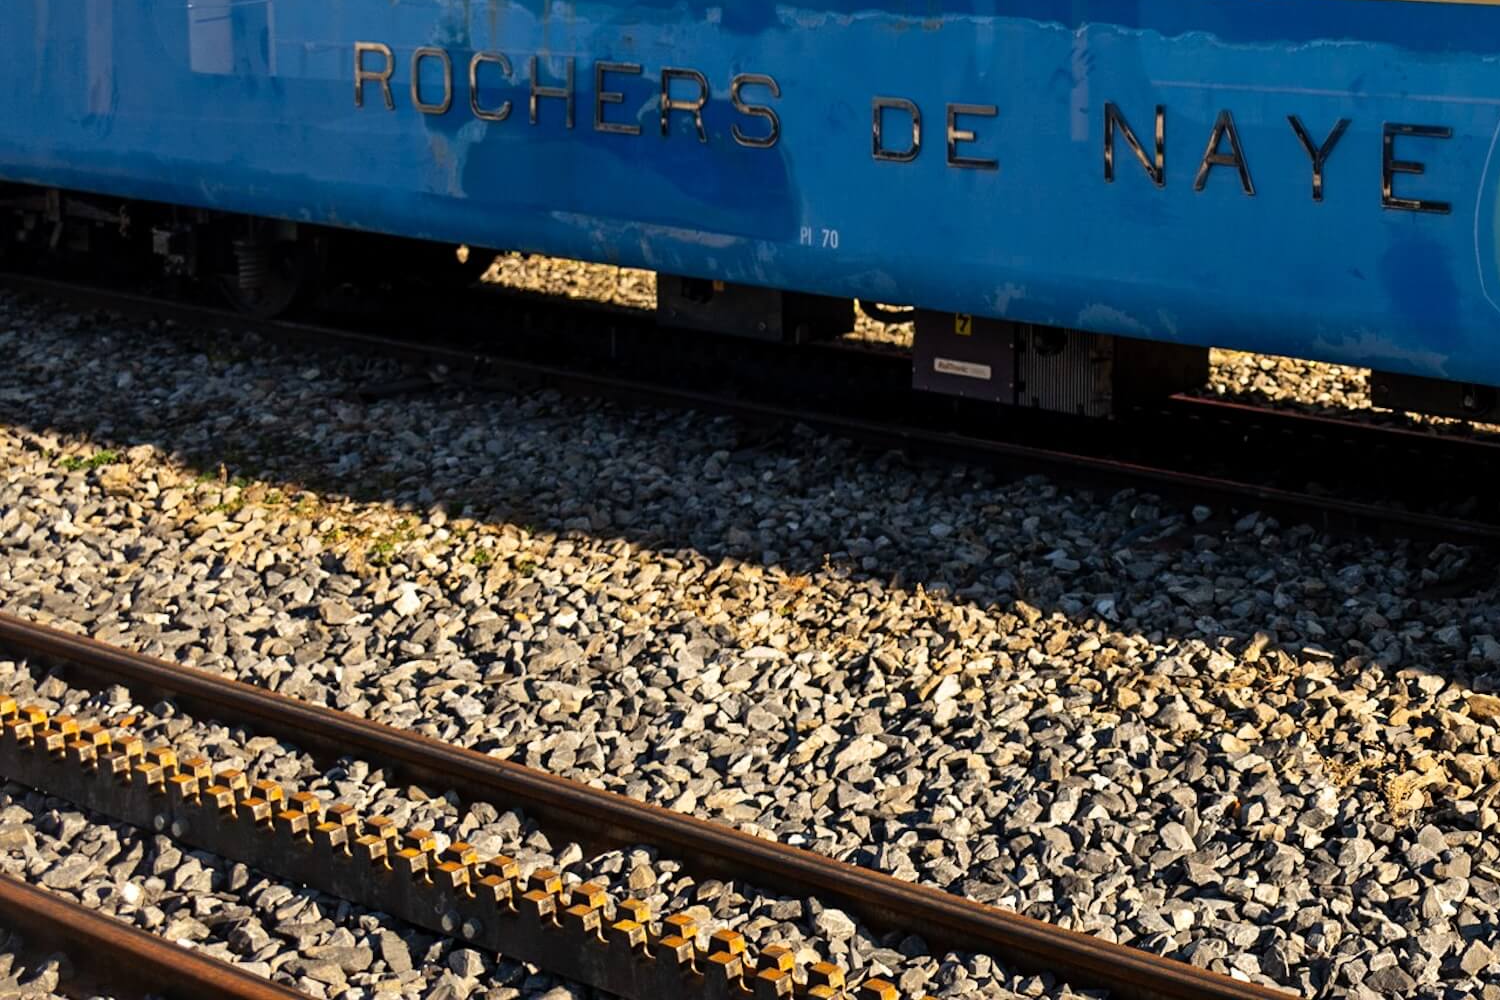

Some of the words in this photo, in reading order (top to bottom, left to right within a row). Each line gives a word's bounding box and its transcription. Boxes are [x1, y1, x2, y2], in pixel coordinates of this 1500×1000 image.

[354, 41, 782, 148] ROCHERS
[872, 96, 998, 170] DE
[1103, 101, 1453, 215] NAYE
[821, 228, 839, 249] 70
